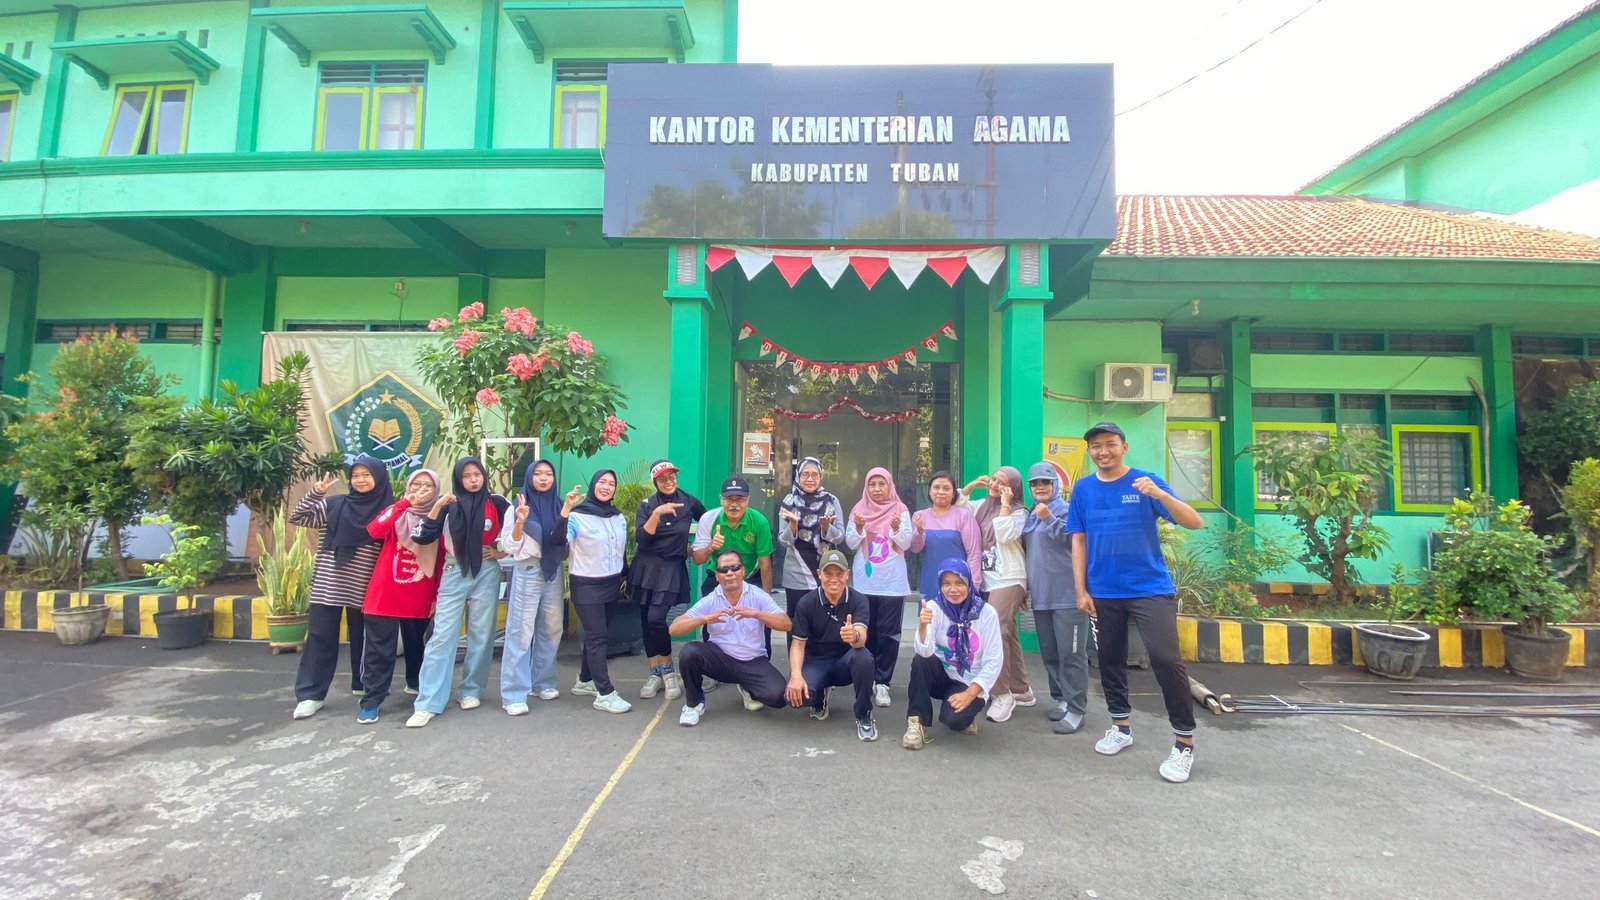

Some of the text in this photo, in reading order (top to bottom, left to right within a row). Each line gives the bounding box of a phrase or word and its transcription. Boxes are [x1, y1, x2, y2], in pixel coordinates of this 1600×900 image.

[649, 115, 1071, 144] KANTOR KEMENTERIAN AGAMA
[751, 162, 959, 183] KABUPATEN TUBAN
[762, 341, 915, 377] DIRGAHAYU
